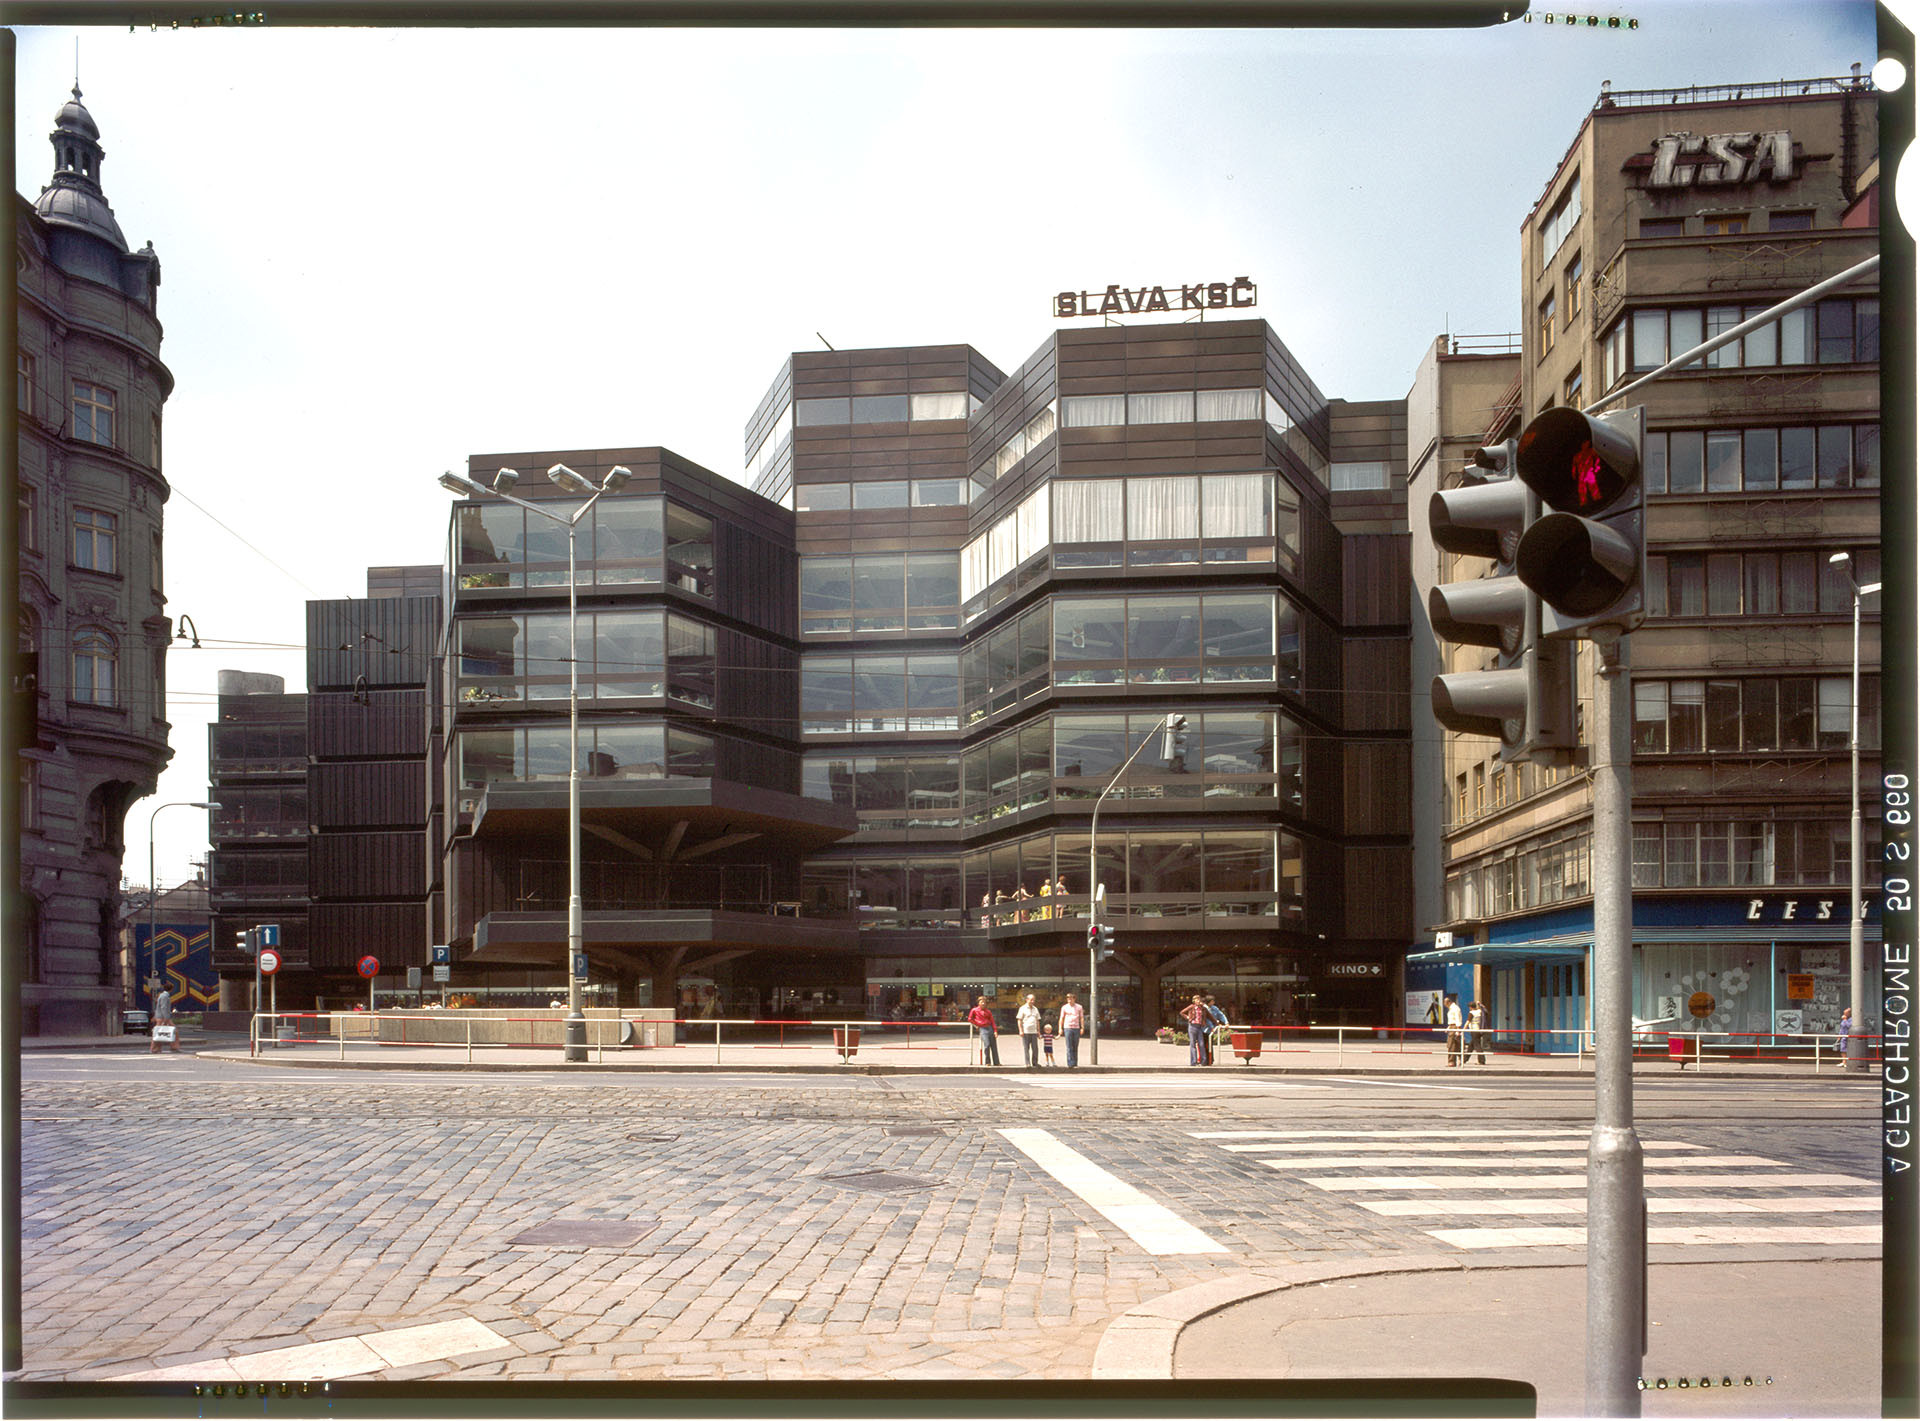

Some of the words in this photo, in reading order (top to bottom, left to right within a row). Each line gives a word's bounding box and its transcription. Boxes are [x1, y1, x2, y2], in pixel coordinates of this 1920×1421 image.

[1058, 285, 1170, 317] SLÁVA
[1182, 276, 1253, 310] KSČ
[437, 949, 445, 960] P
[577, 957, 584, 973] P
[1331, 965, 1367, 974] KINO
